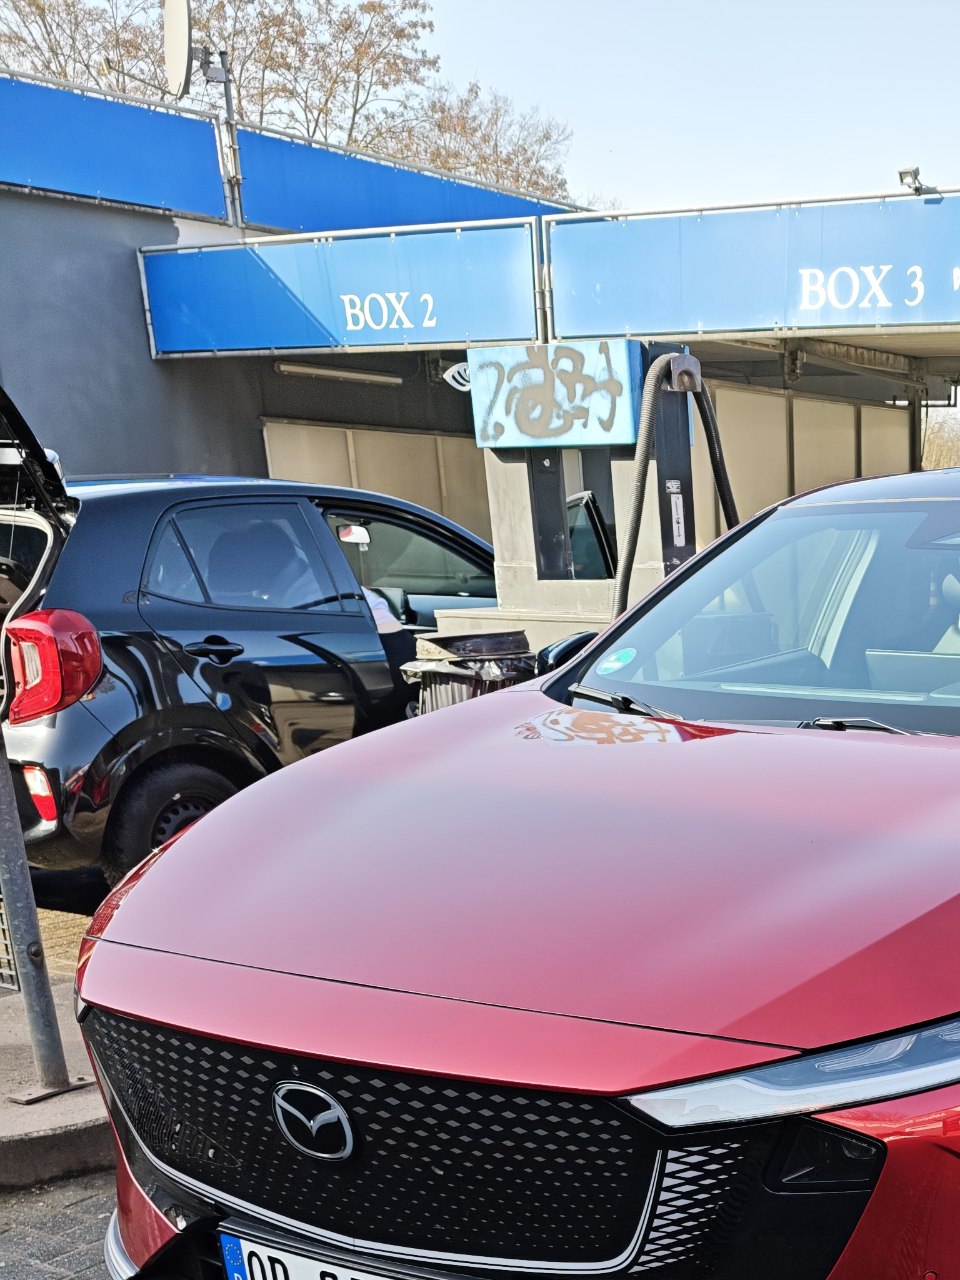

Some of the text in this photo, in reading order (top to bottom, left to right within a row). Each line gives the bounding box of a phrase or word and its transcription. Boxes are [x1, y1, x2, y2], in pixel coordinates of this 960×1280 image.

[798, 264, 925, 310] BOX 3
[340, 291, 437, 331] BOX 2
